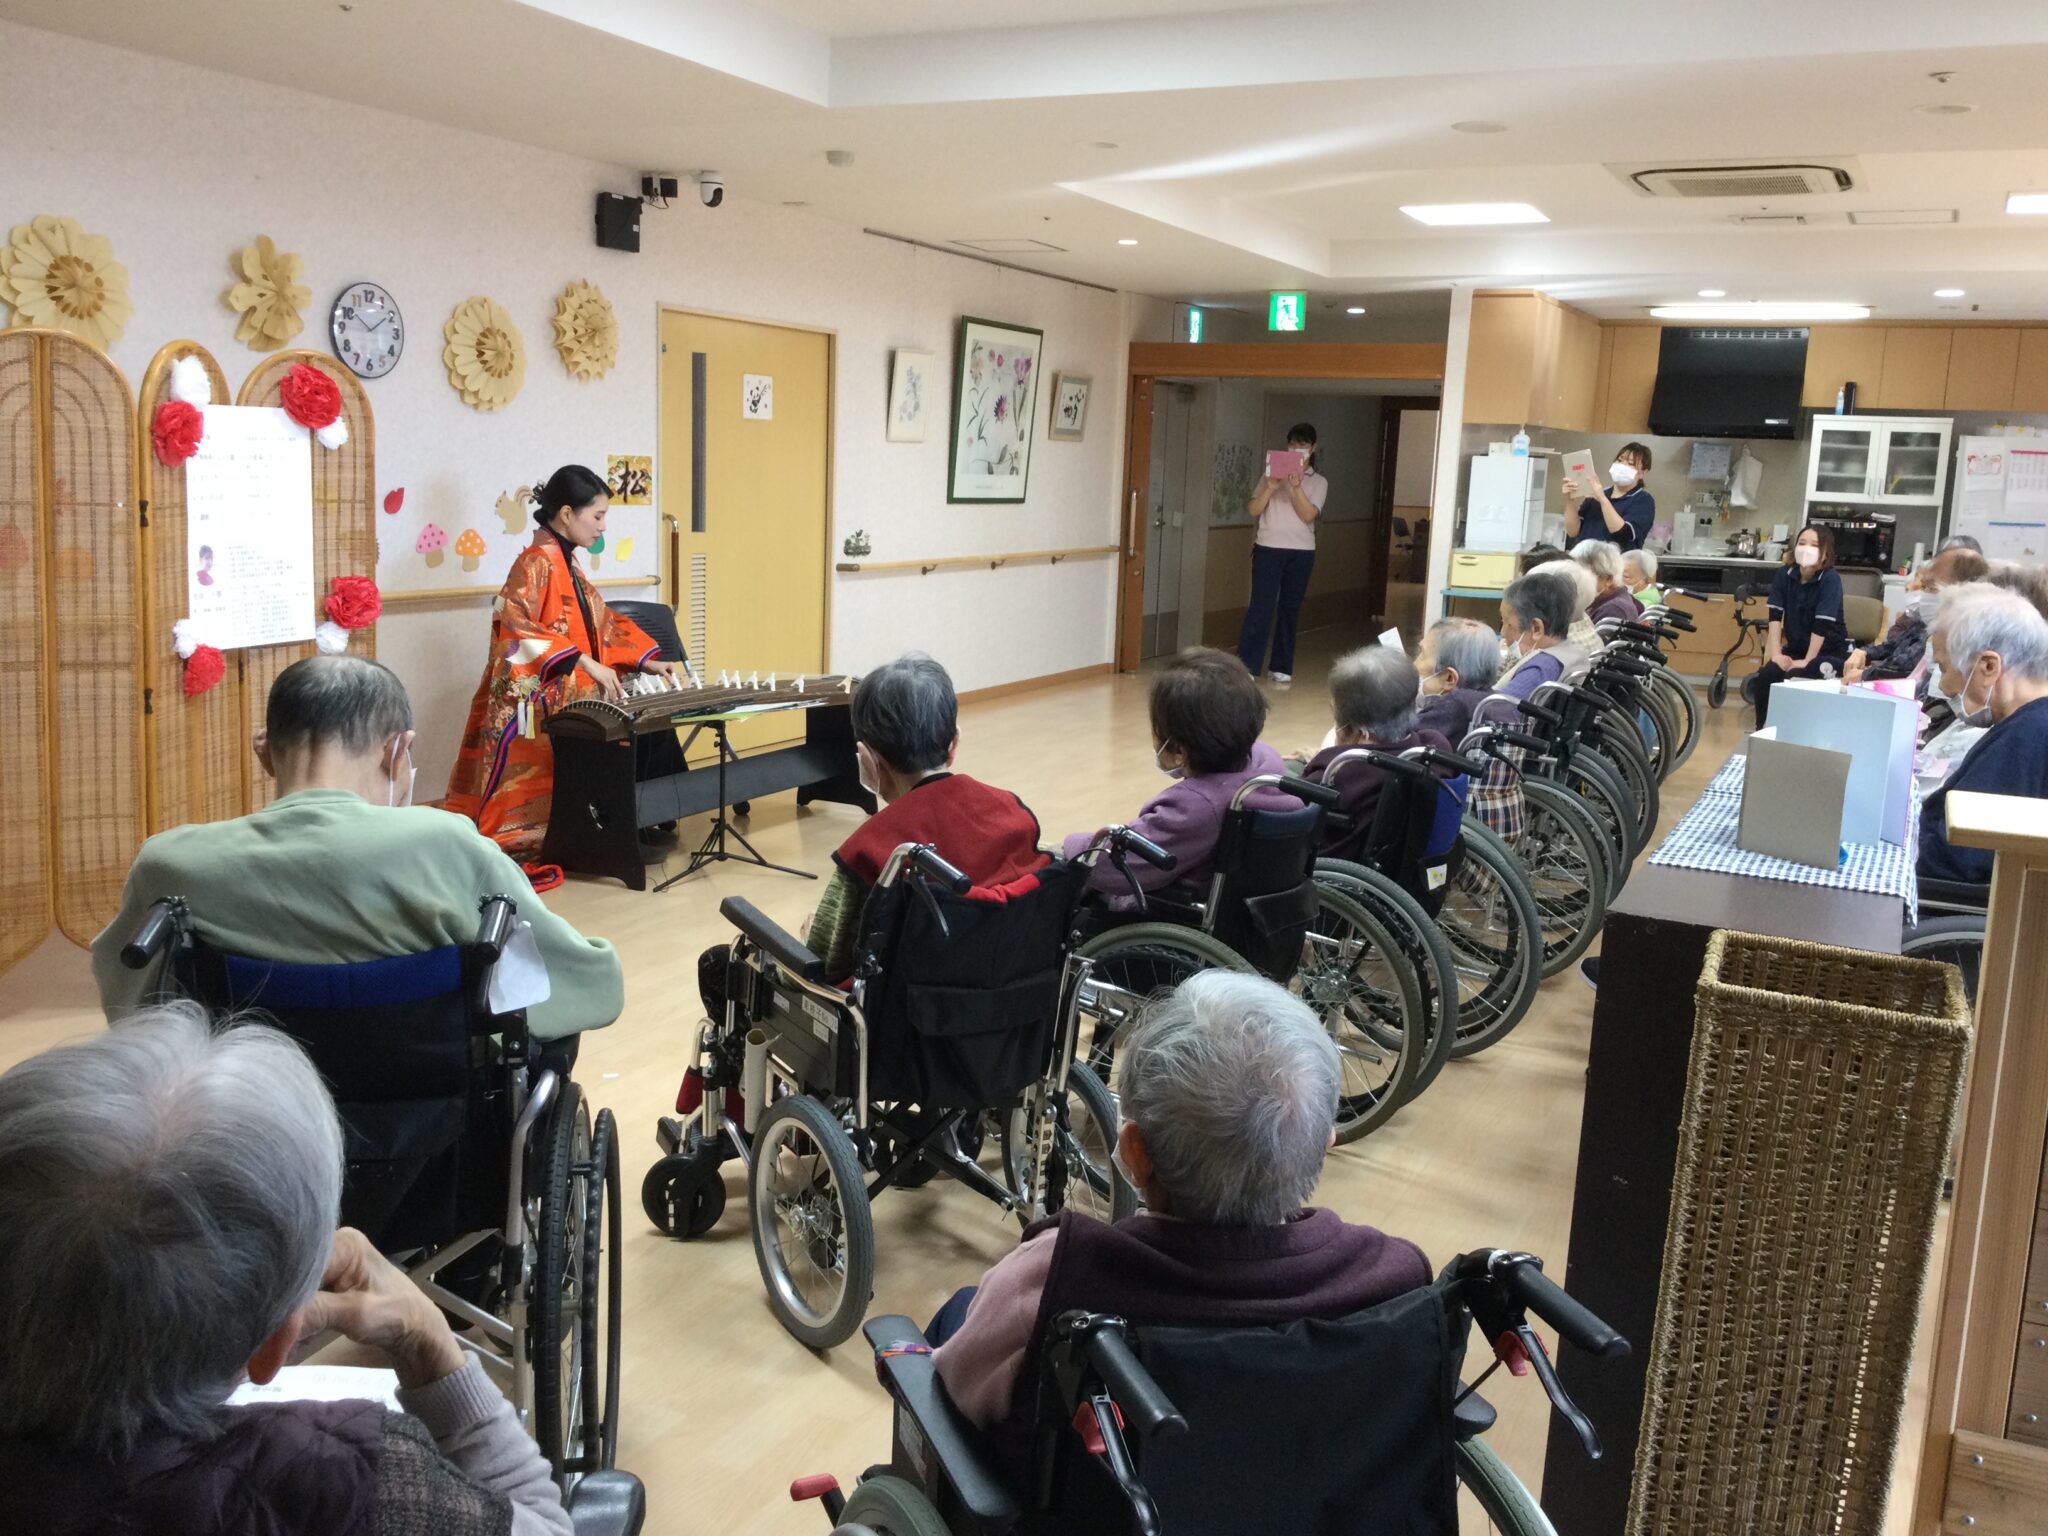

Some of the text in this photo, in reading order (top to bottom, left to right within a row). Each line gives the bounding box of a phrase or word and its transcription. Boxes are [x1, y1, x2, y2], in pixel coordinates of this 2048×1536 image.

[351, 294, 362, 307] 11
[363, 289, 375, 303] 12
[342, 306, 354, 320] 10
[388, 310, 395, 323] 2
[338, 321, 346, 334] 9
[392, 327, 400, 340] 3
[343, 339, 351, 352] 8
[388, 344, 395, 357] 4
[353, 352, 361, 365] 7
[366, 358, 373, 371] 6
[379, 355, 385, 368] 5
[617, 460, 647, 504] 松
